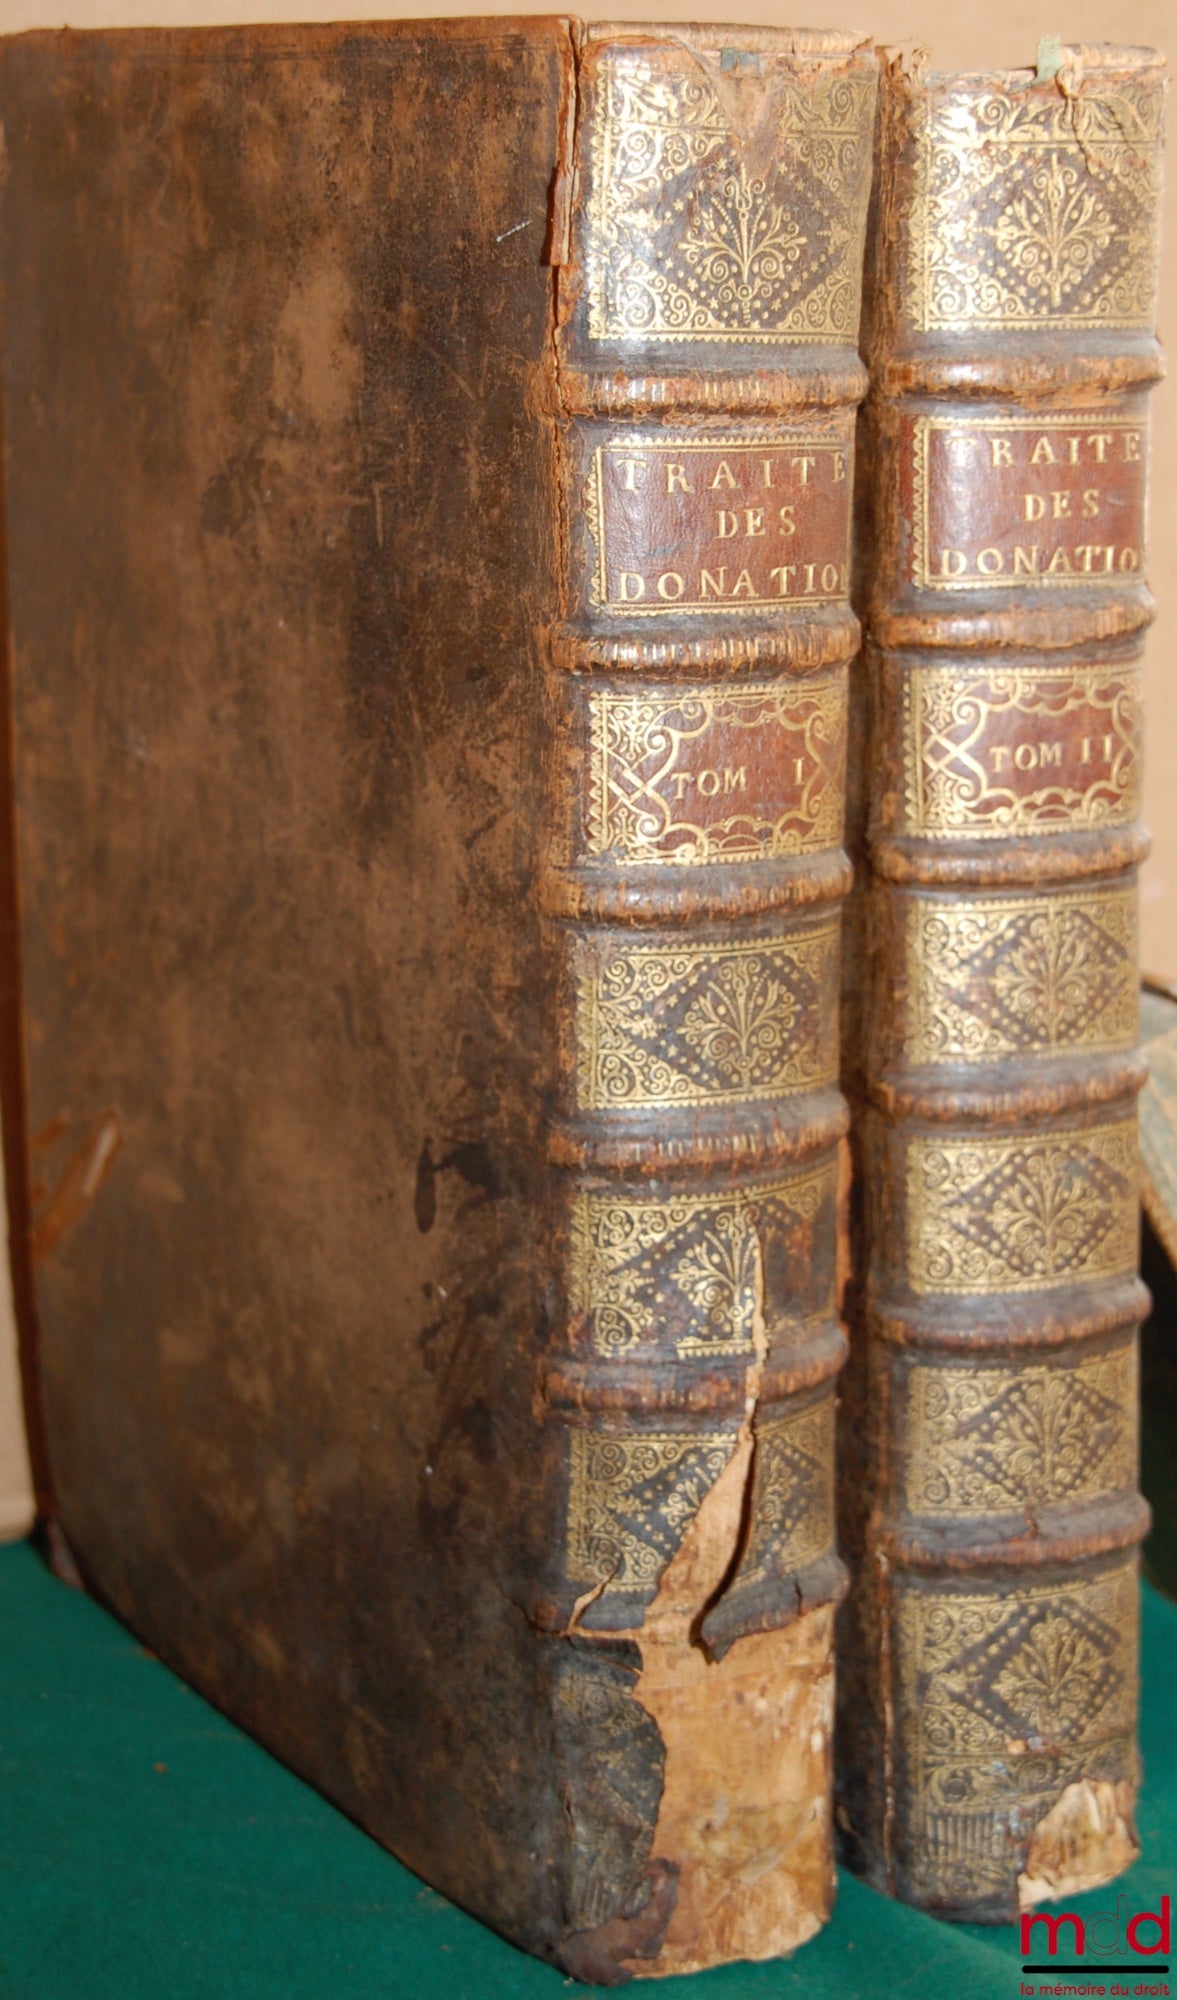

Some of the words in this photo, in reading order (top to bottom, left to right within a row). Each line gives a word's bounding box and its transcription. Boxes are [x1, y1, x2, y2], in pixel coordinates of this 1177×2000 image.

[944, 432, 1141, 468] TRAITE
[615, 452, 846, 493] TRAITE
[715, 505, 796, 538] DES
[1024, 489, 1100, 521] DES
[990, 741, 1062, 773] TOM
[1080, 734, 1114, 765] II
[670, 766, 747, 800] TOM
[792, 756, 806, 786] I
